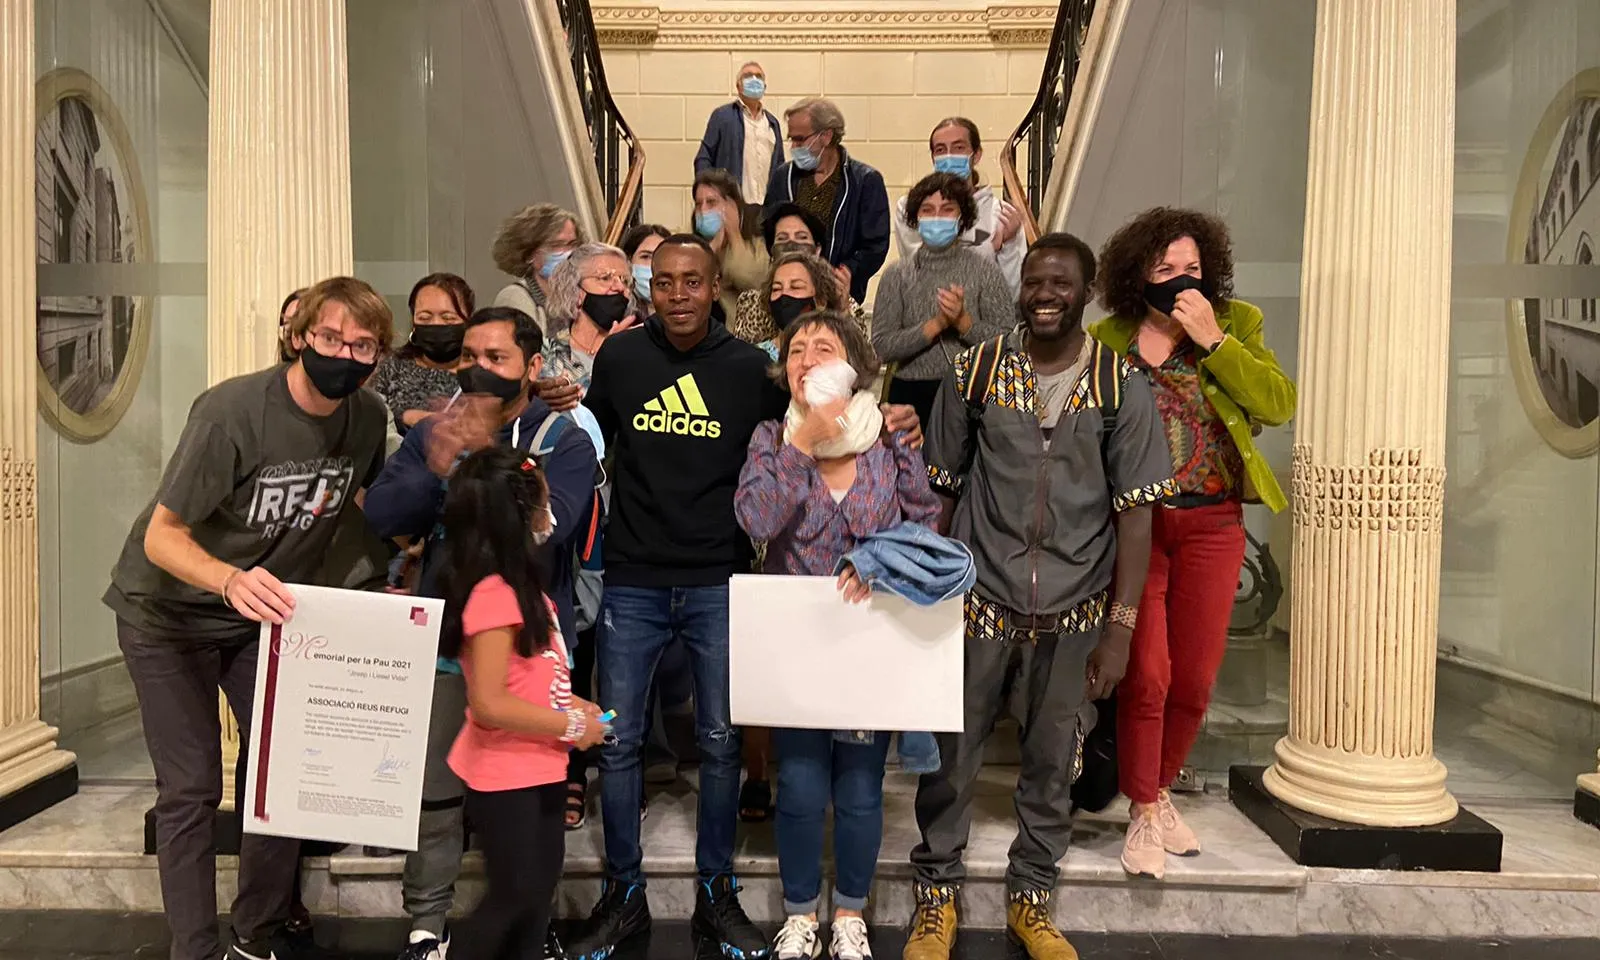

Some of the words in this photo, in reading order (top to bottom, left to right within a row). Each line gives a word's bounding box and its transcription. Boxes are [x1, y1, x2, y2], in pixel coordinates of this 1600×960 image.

[632, 410, 721, 438] adidas
[272, 631, 346, 664] Memorial
[346, 656, 361, 666] per
[363, 657, 372, 666] la
[373, 657, 390, 668] Pau
[391, 660, 412, 669] 2021
[307, 696, 356, 711] ASSOCIACIÓ
[357, 702, 379, 713] REUS
[379, 705, 409, 715] REFUGI
